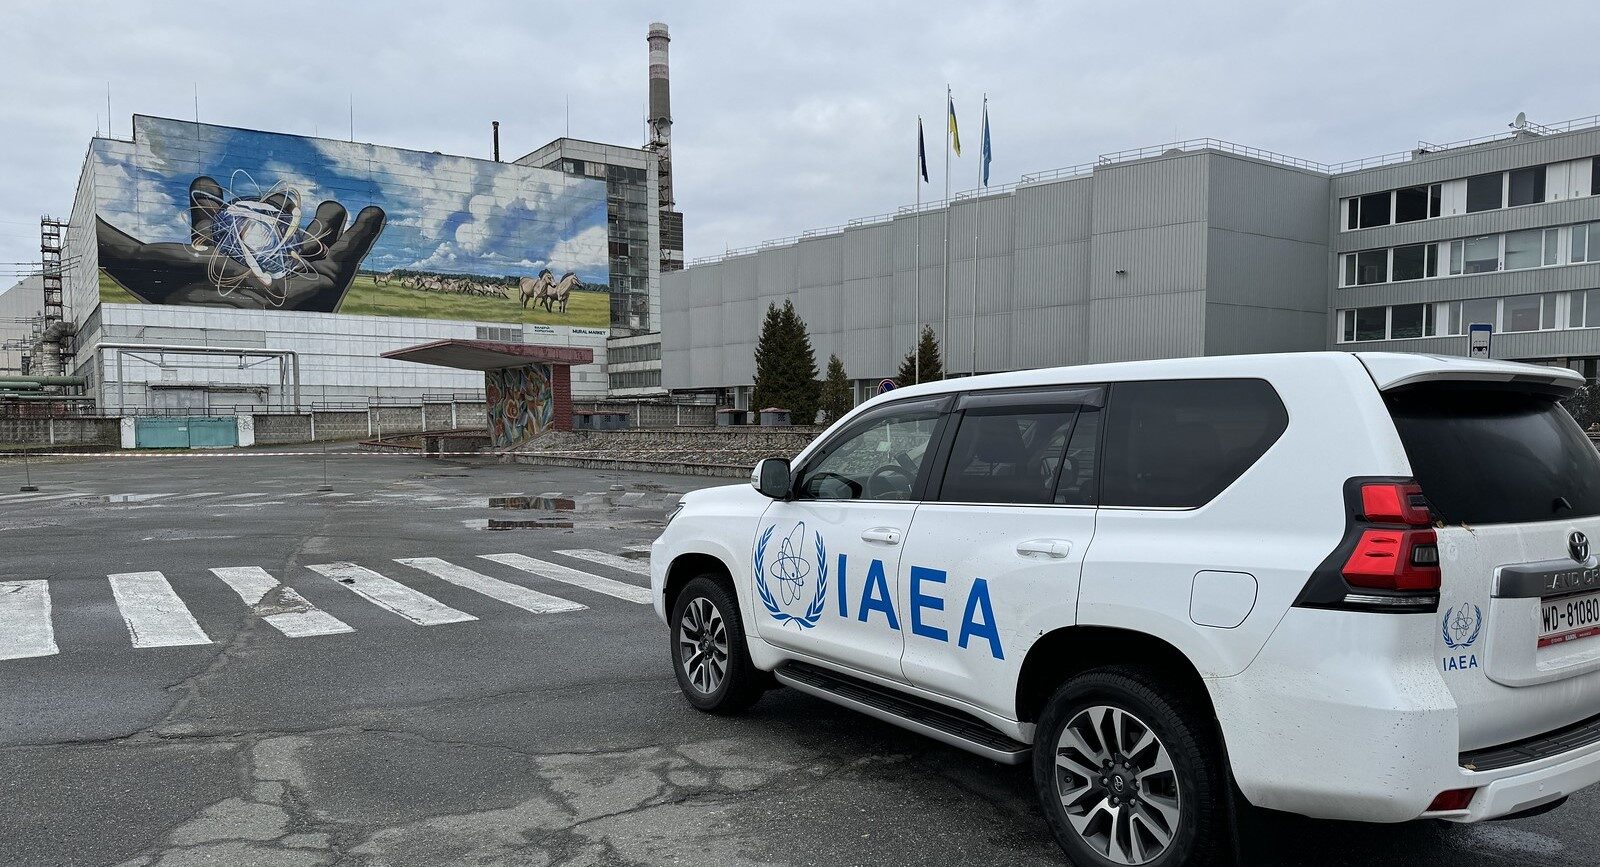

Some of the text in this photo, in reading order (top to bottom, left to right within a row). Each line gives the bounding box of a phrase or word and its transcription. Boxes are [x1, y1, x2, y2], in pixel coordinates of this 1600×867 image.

[1543, 572, 1580, 589] LAND
[837, 553, 1005, 661] IAEA
[1542, 598, 1600, 632] WD-81080
[1443, 654, 1478, 671] IAEA
